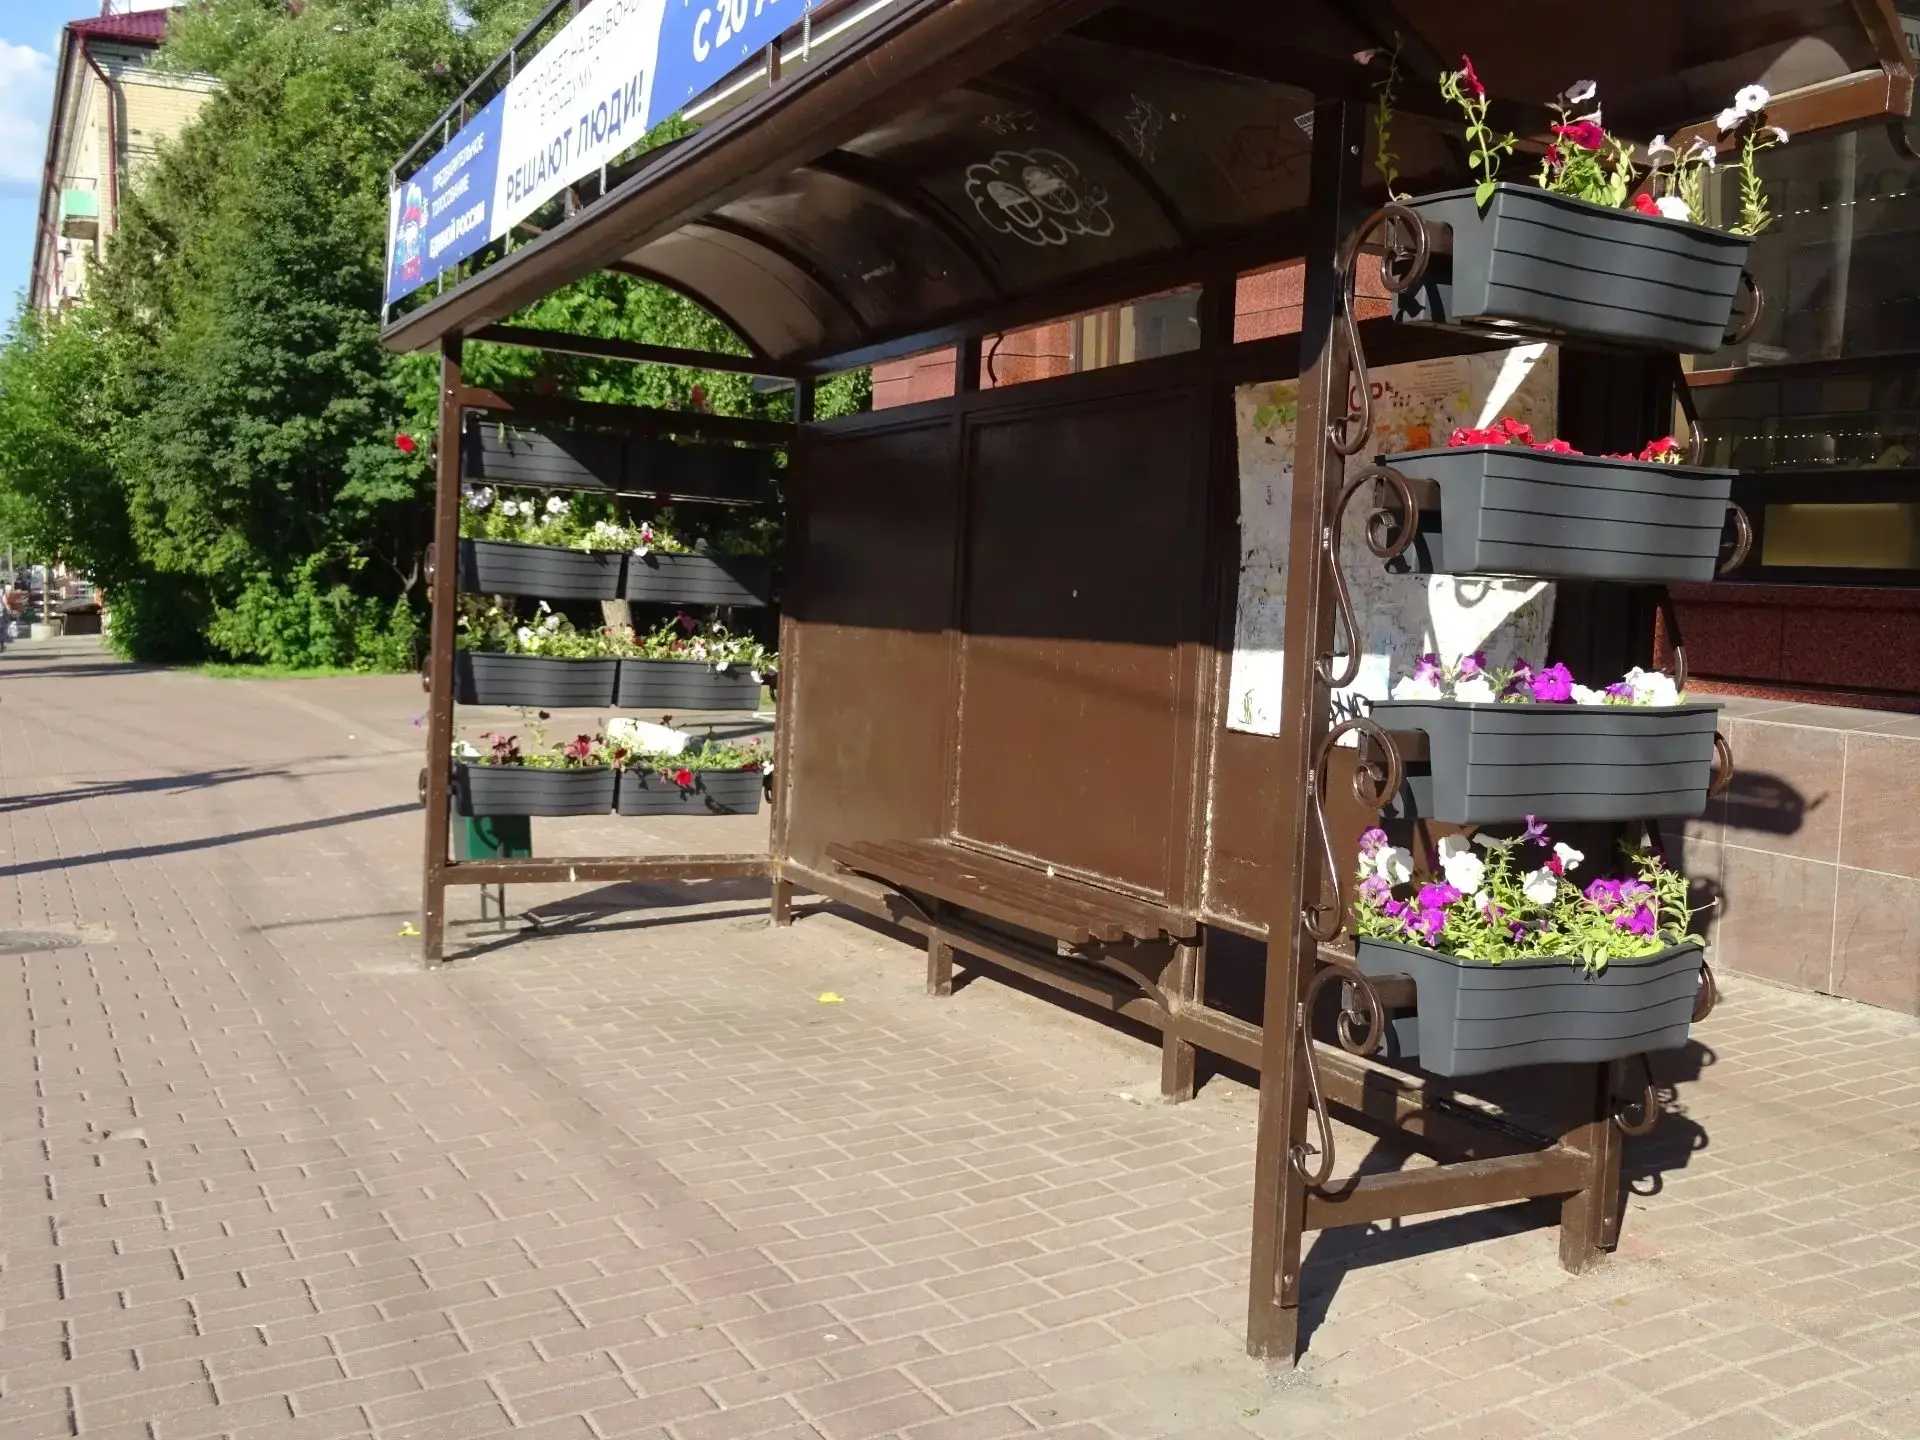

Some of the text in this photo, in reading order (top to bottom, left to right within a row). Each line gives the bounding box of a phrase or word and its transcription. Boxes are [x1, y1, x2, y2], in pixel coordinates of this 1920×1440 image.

[692, 0, 749, 63] С 20
[506, 69, 644, 209] РЕШАЮТ ЛЮДИ!
